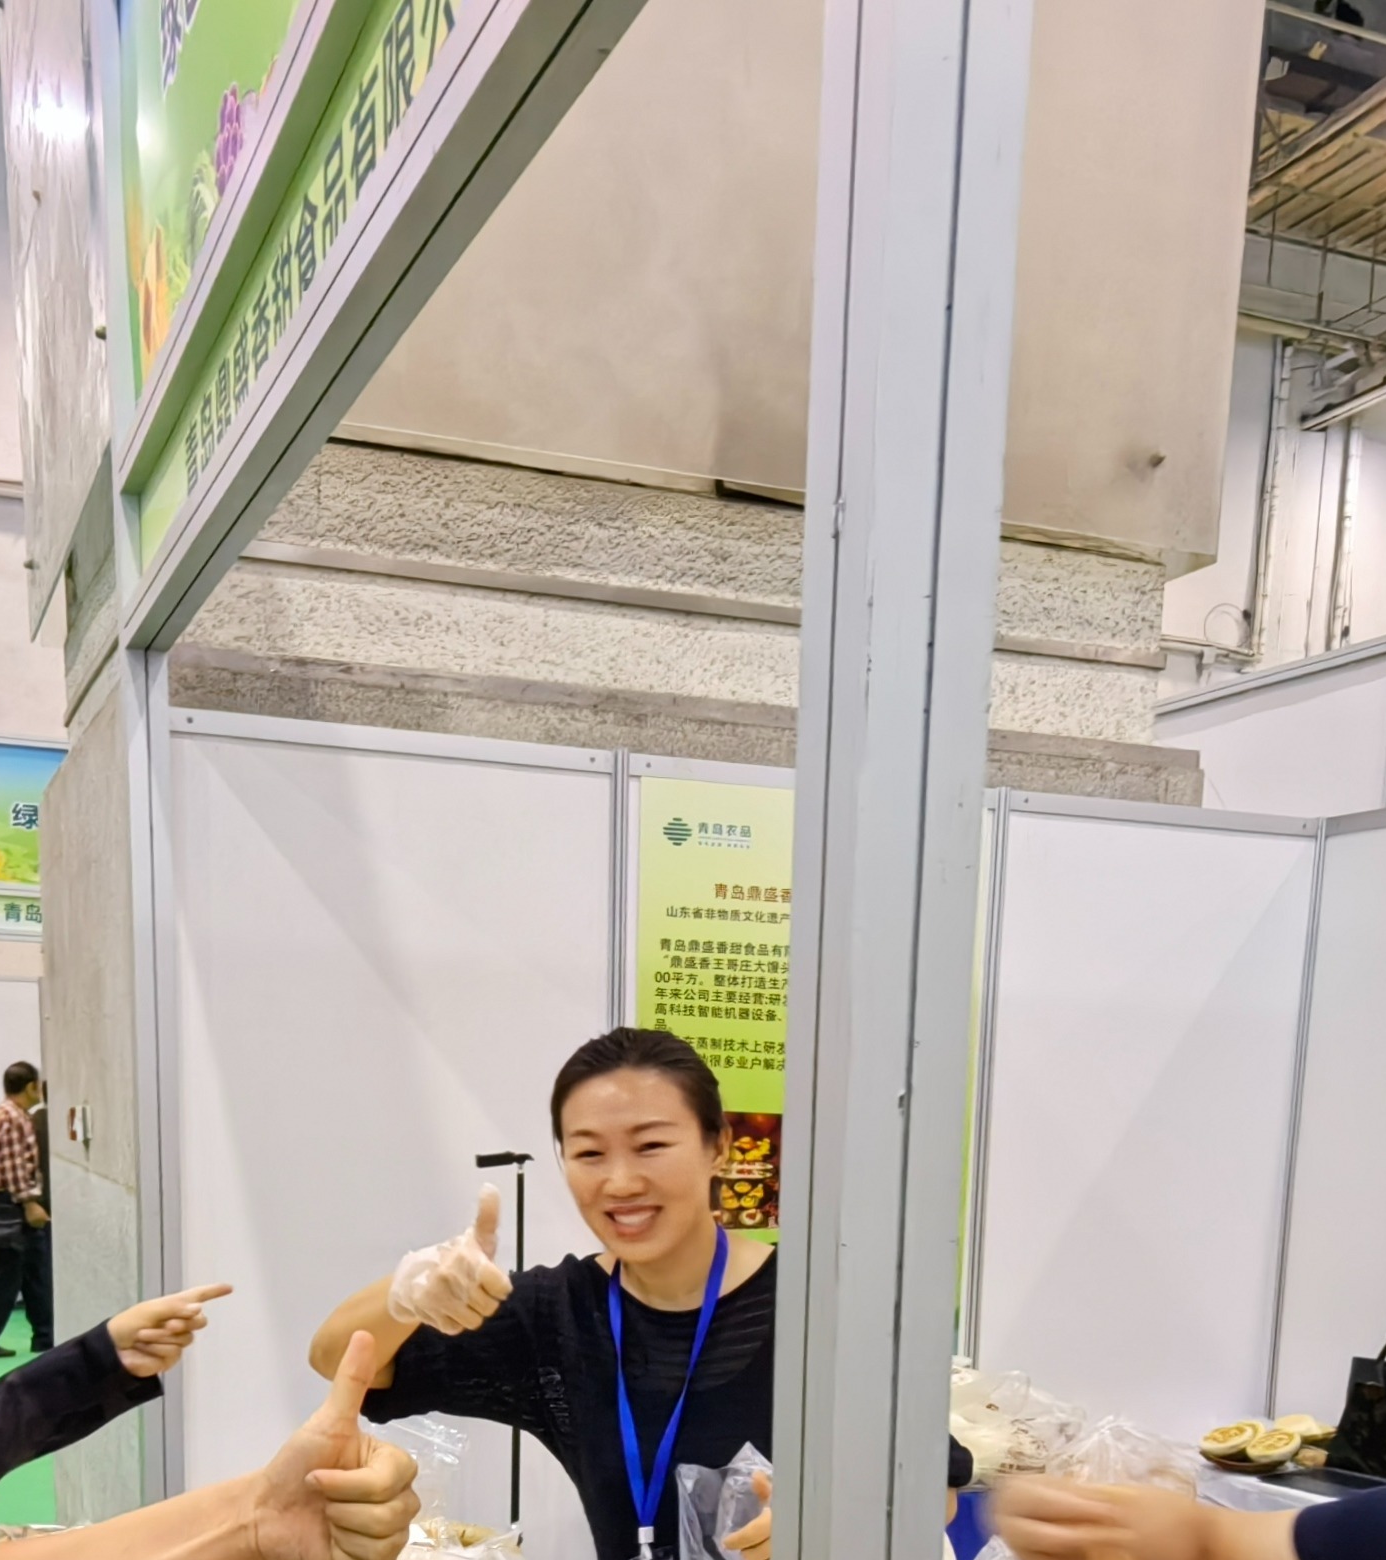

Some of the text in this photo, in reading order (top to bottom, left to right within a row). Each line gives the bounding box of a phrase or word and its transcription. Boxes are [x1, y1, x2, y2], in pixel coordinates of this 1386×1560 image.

[4, 902, 43, 923] 青岛
[666, 905, 791, 924] 山东省非物质文化遗产
